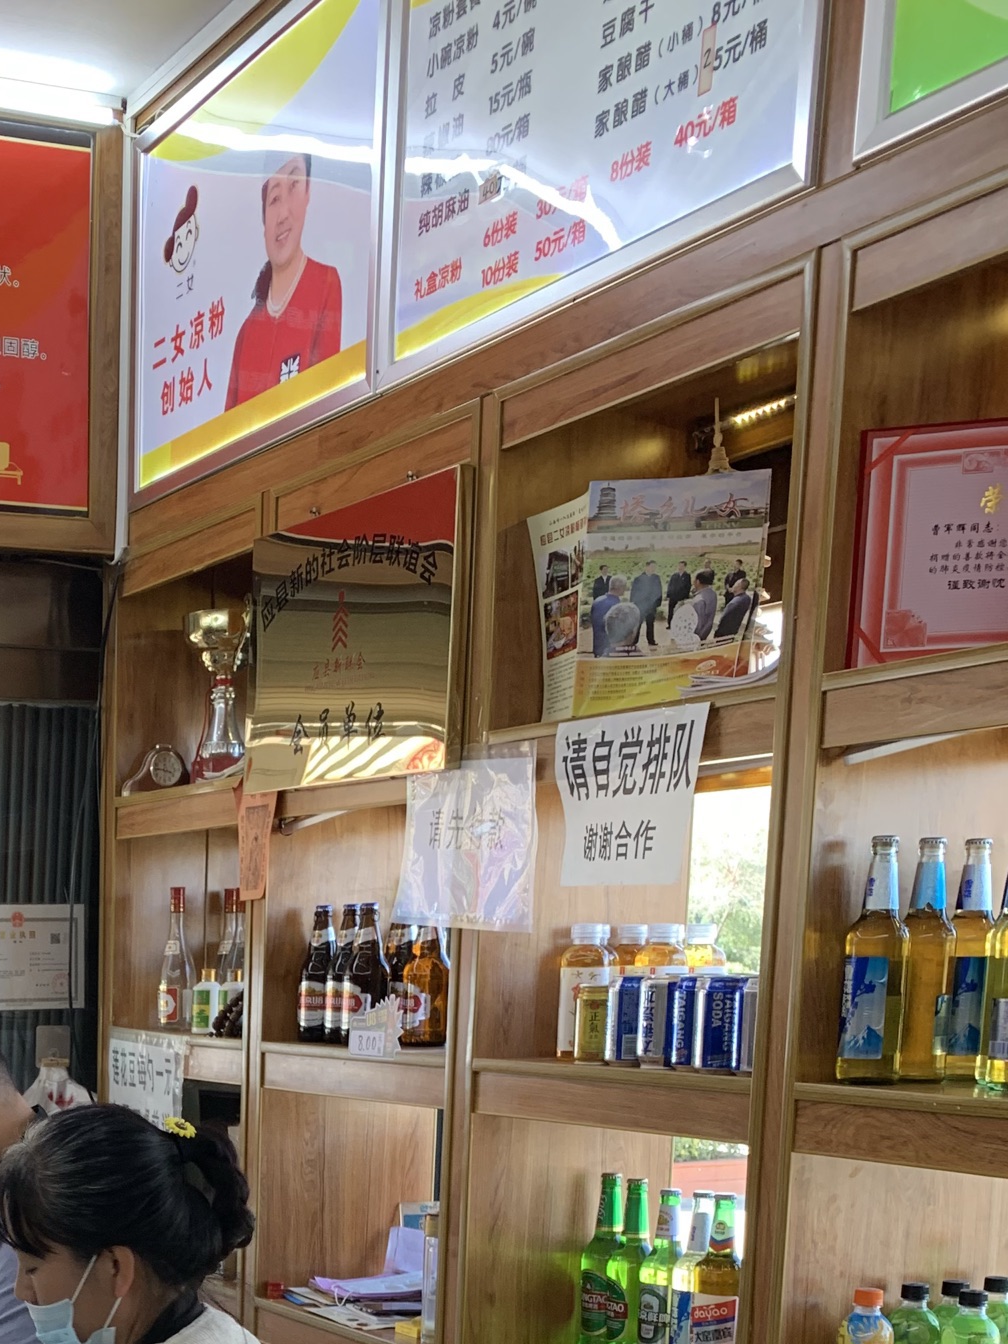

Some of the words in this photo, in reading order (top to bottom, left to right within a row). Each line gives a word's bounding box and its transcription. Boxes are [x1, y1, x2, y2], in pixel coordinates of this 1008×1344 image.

[426, 23, 479, 79] 小碗凉粉
[490, 26, 536, 75] 5元/碗
[488, 68, 533, 116] 15元/瓶
[609, 140, 653, 183] 8份装
[673, 95, 739, 148] 40元/箱
[417, 188, 471, 237] 纯胡麻油
[482, 210, 519, 248] 6份装
[413, 256, 463, 302] 礼盒凉粉
[480, 250, 520, 289] 10份装
[533, 217, 587, 262] 50元/箱
[152, 296, 226, 371] 二女凉粉
[160, 357, 213, 416] 创始人
[260, 532, 439, 632] 应县新的社会阶层联谊会
[290, 700, 387, 757] 会员单位
[561, 719, 696, 802] 请自觉排队
[583, 818, 657, 862] 谢谢合作
[711, 991, 724, 1028] SODA
